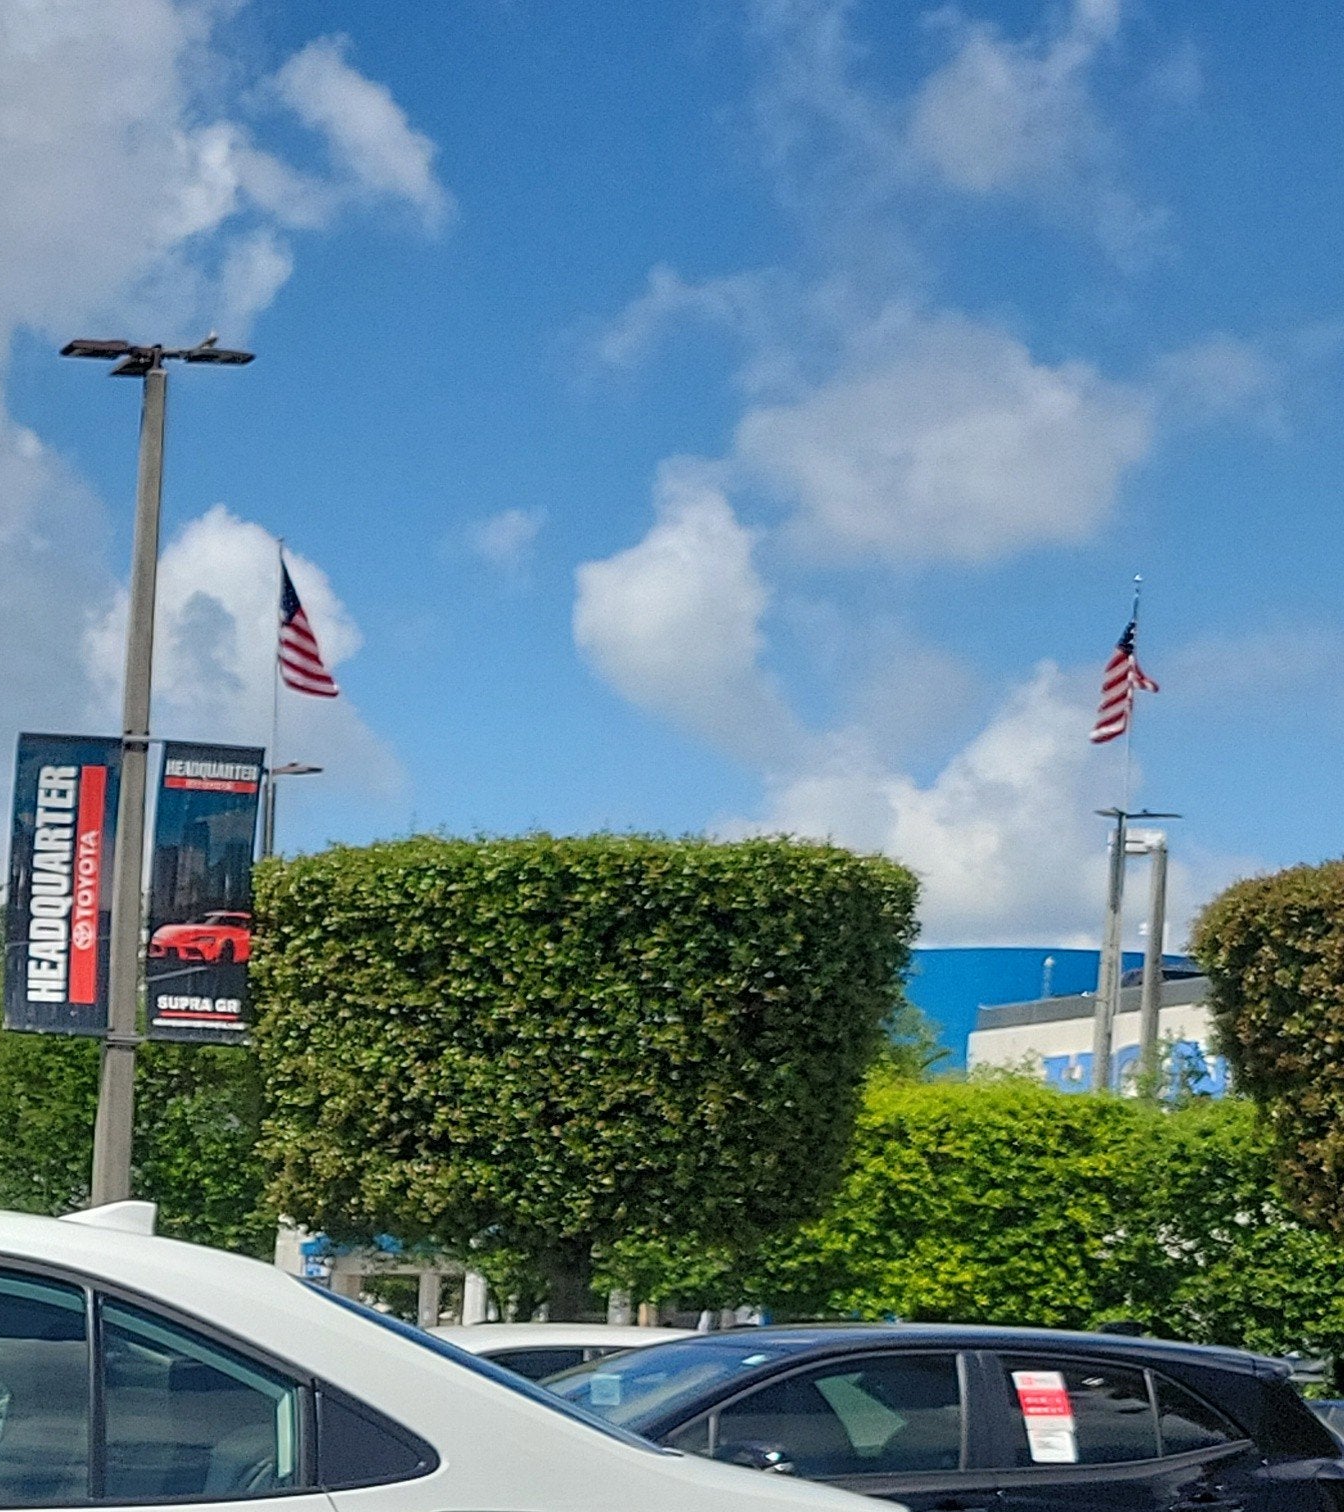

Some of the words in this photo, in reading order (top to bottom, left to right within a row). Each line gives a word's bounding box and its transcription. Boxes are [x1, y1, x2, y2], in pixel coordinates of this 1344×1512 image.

[166, 760, 258, 782] HEADQUARTER
[26, 765, 78, 1003] HEADQUARTER
[75, 831, 99, 919] TOYOTA
[157, 995, 213, 1012] SUPRA
[215, 998, 242, 1014] GR
